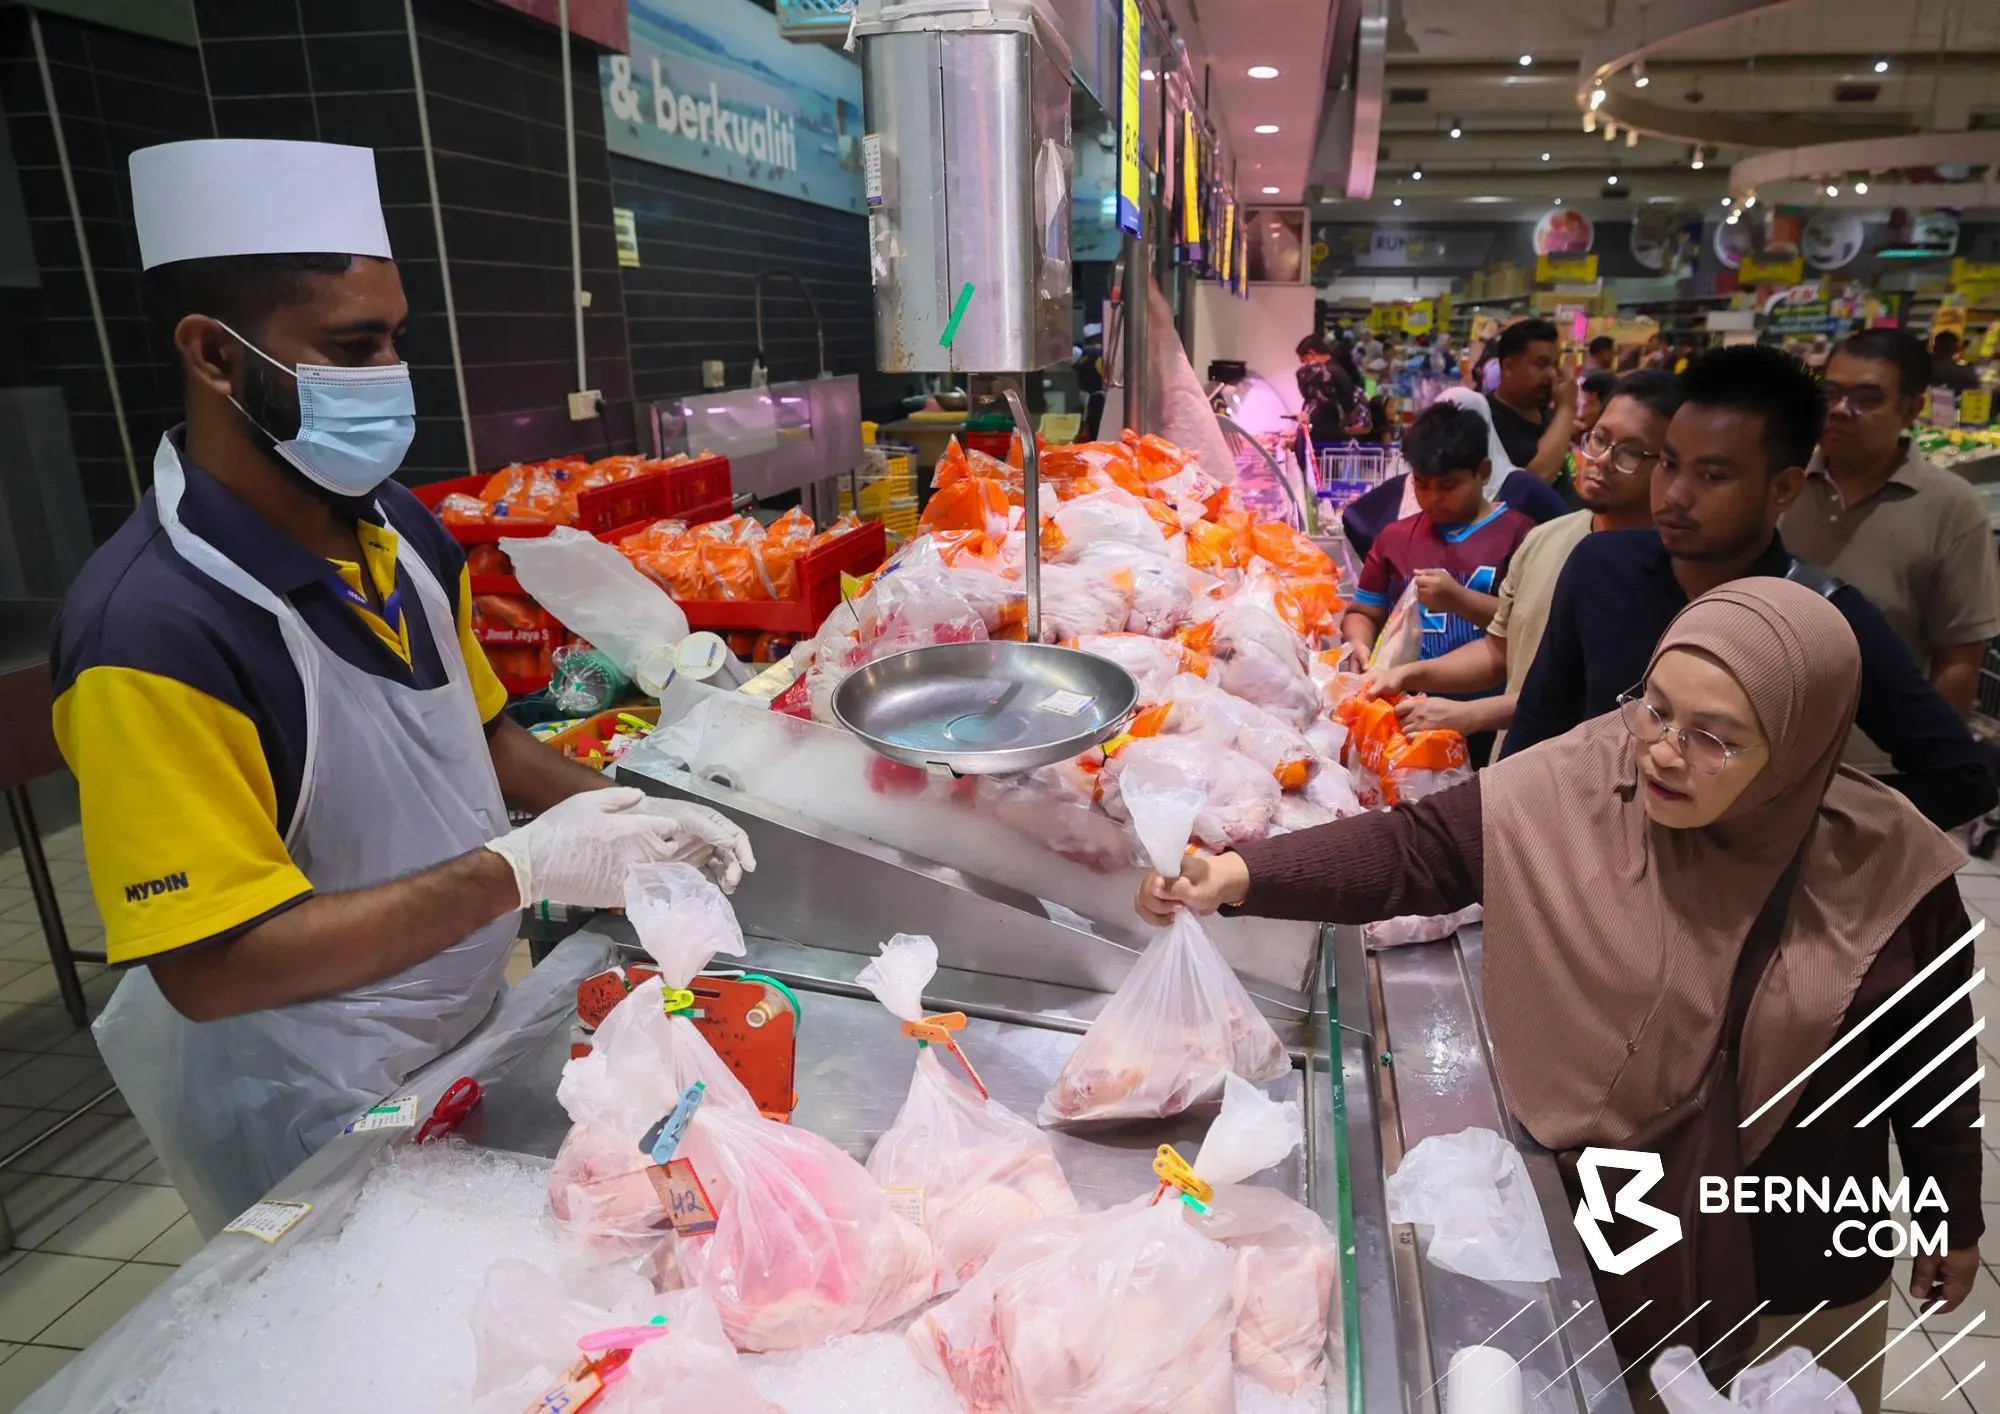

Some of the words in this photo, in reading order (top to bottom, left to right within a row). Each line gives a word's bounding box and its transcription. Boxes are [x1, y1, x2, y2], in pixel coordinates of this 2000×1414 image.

[652, 57, 797, 172] berkualiti
[124, 872, 189, 903] MYDIN
[668, 1188, 704, 1216] 42
